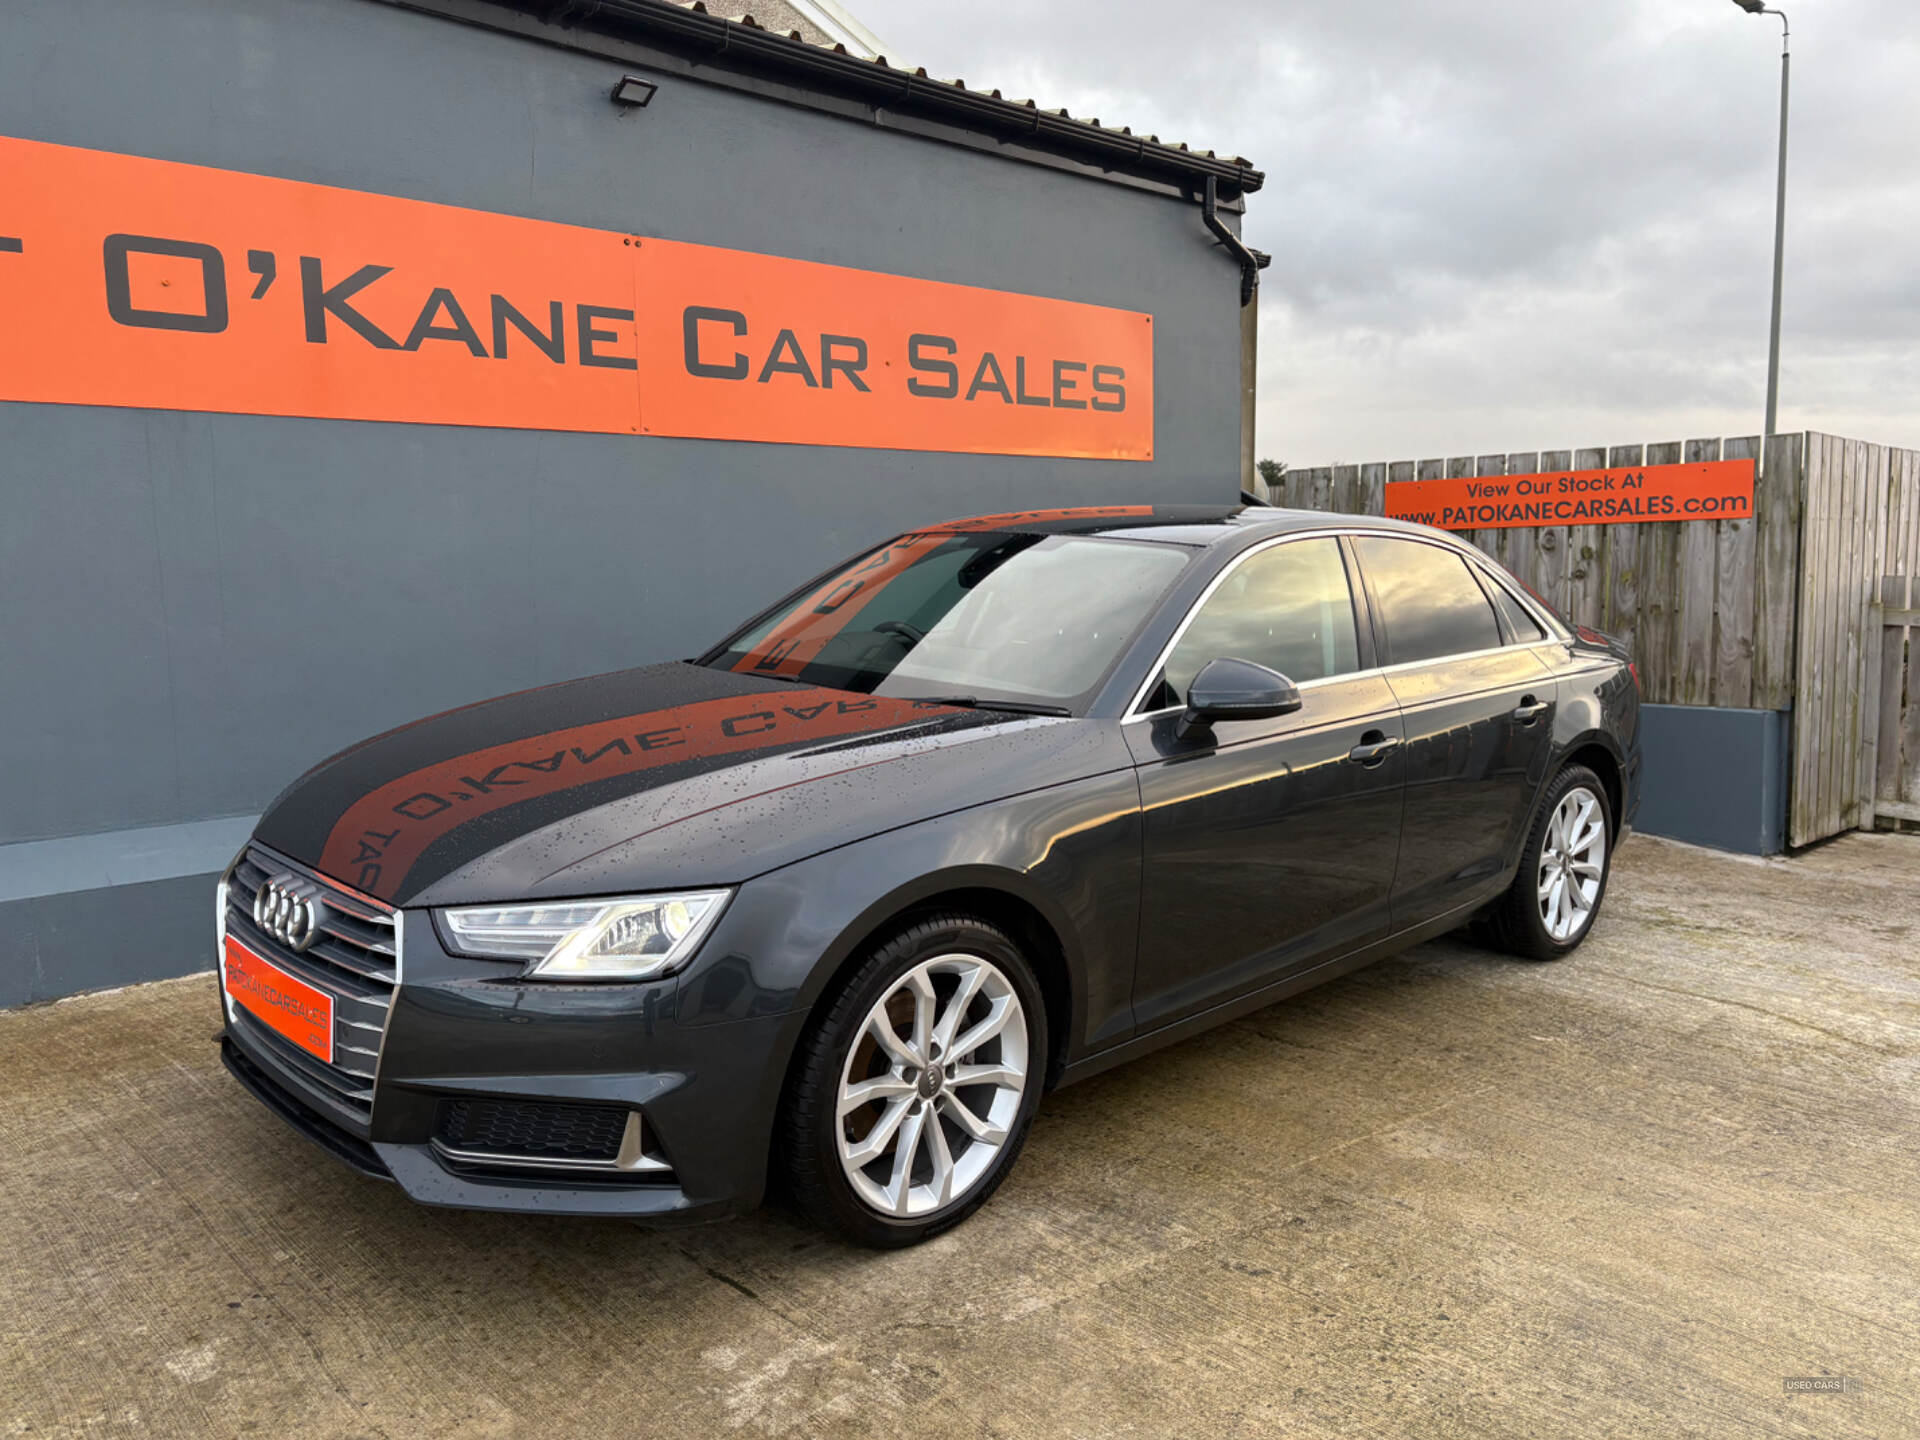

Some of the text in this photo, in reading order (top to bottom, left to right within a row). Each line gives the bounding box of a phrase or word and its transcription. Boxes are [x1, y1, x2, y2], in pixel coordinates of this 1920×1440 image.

[103, 233, 1126, 413] O'KANE CAR SALES
[1466, 473, 1645, 499] View Our Stock At
[1389, 494, 1748, 524] ww.PATOKANECARSALES.com
